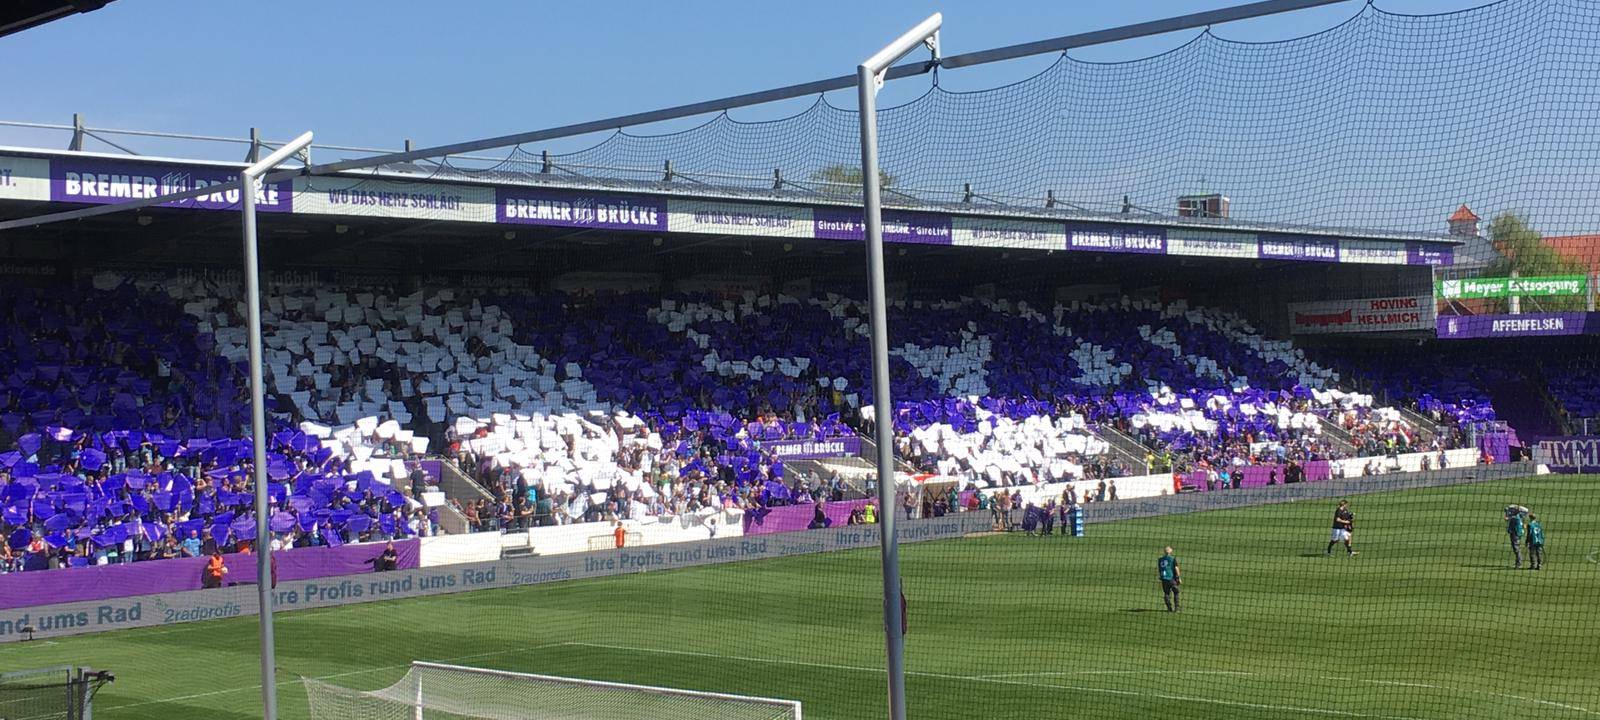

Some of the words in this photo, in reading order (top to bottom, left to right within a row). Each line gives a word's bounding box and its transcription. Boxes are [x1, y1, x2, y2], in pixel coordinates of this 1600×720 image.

[65, 171, 158, 198] BREMER
[329, 188, 349, 204] WO
[352, 190, 377, 206] DAS
[379, 192, 408, 208] HERZ
[410, 192, 465, 211] SCHLÄGT.
[506, 198, 571, 220] BREMER
[597, 200, 658, 225] BRÜCKE
[712, 212, 730, 225] DAS
[731, 213, 753, 226] HERZ
[1072, 230, 1111, 247] BREMER
[1124, 230, 1162, 250] BRÜCKE
[1465, 281, 1504, 296] Meyer
[1508, 280, 1579, 293] Entsorgung
[1371, 298, 1418, 310] HOVING
[1358, 312, 1419, 325] HELLMICH
[1492, 317, 1564, 332] AFFENFELSEN
[814, 441, 845, 454] BRÜCKE
[837, 530, 860, 545] Ihre
[903, 526, 930, 539] rund
[933, 522, 958, 536] ums
[585, 556, 615, 573] Ihre
[619, 549, 664, 570] Profis
[668, 547, 700, 562] rund
[706, 544, 736, 559] ums
[741, 538, 768, 556] Rad
[305, 580, 363, 602] Profis
[370, 575, 412, 594] rund
[420, 570, 456, 589] ums
[462, 565, 497, 585] Rad
[38, 611, 89, 630] ums
[98, 603, 142, 625] Rad
[164, 601, 241, 624] 2radprofis
